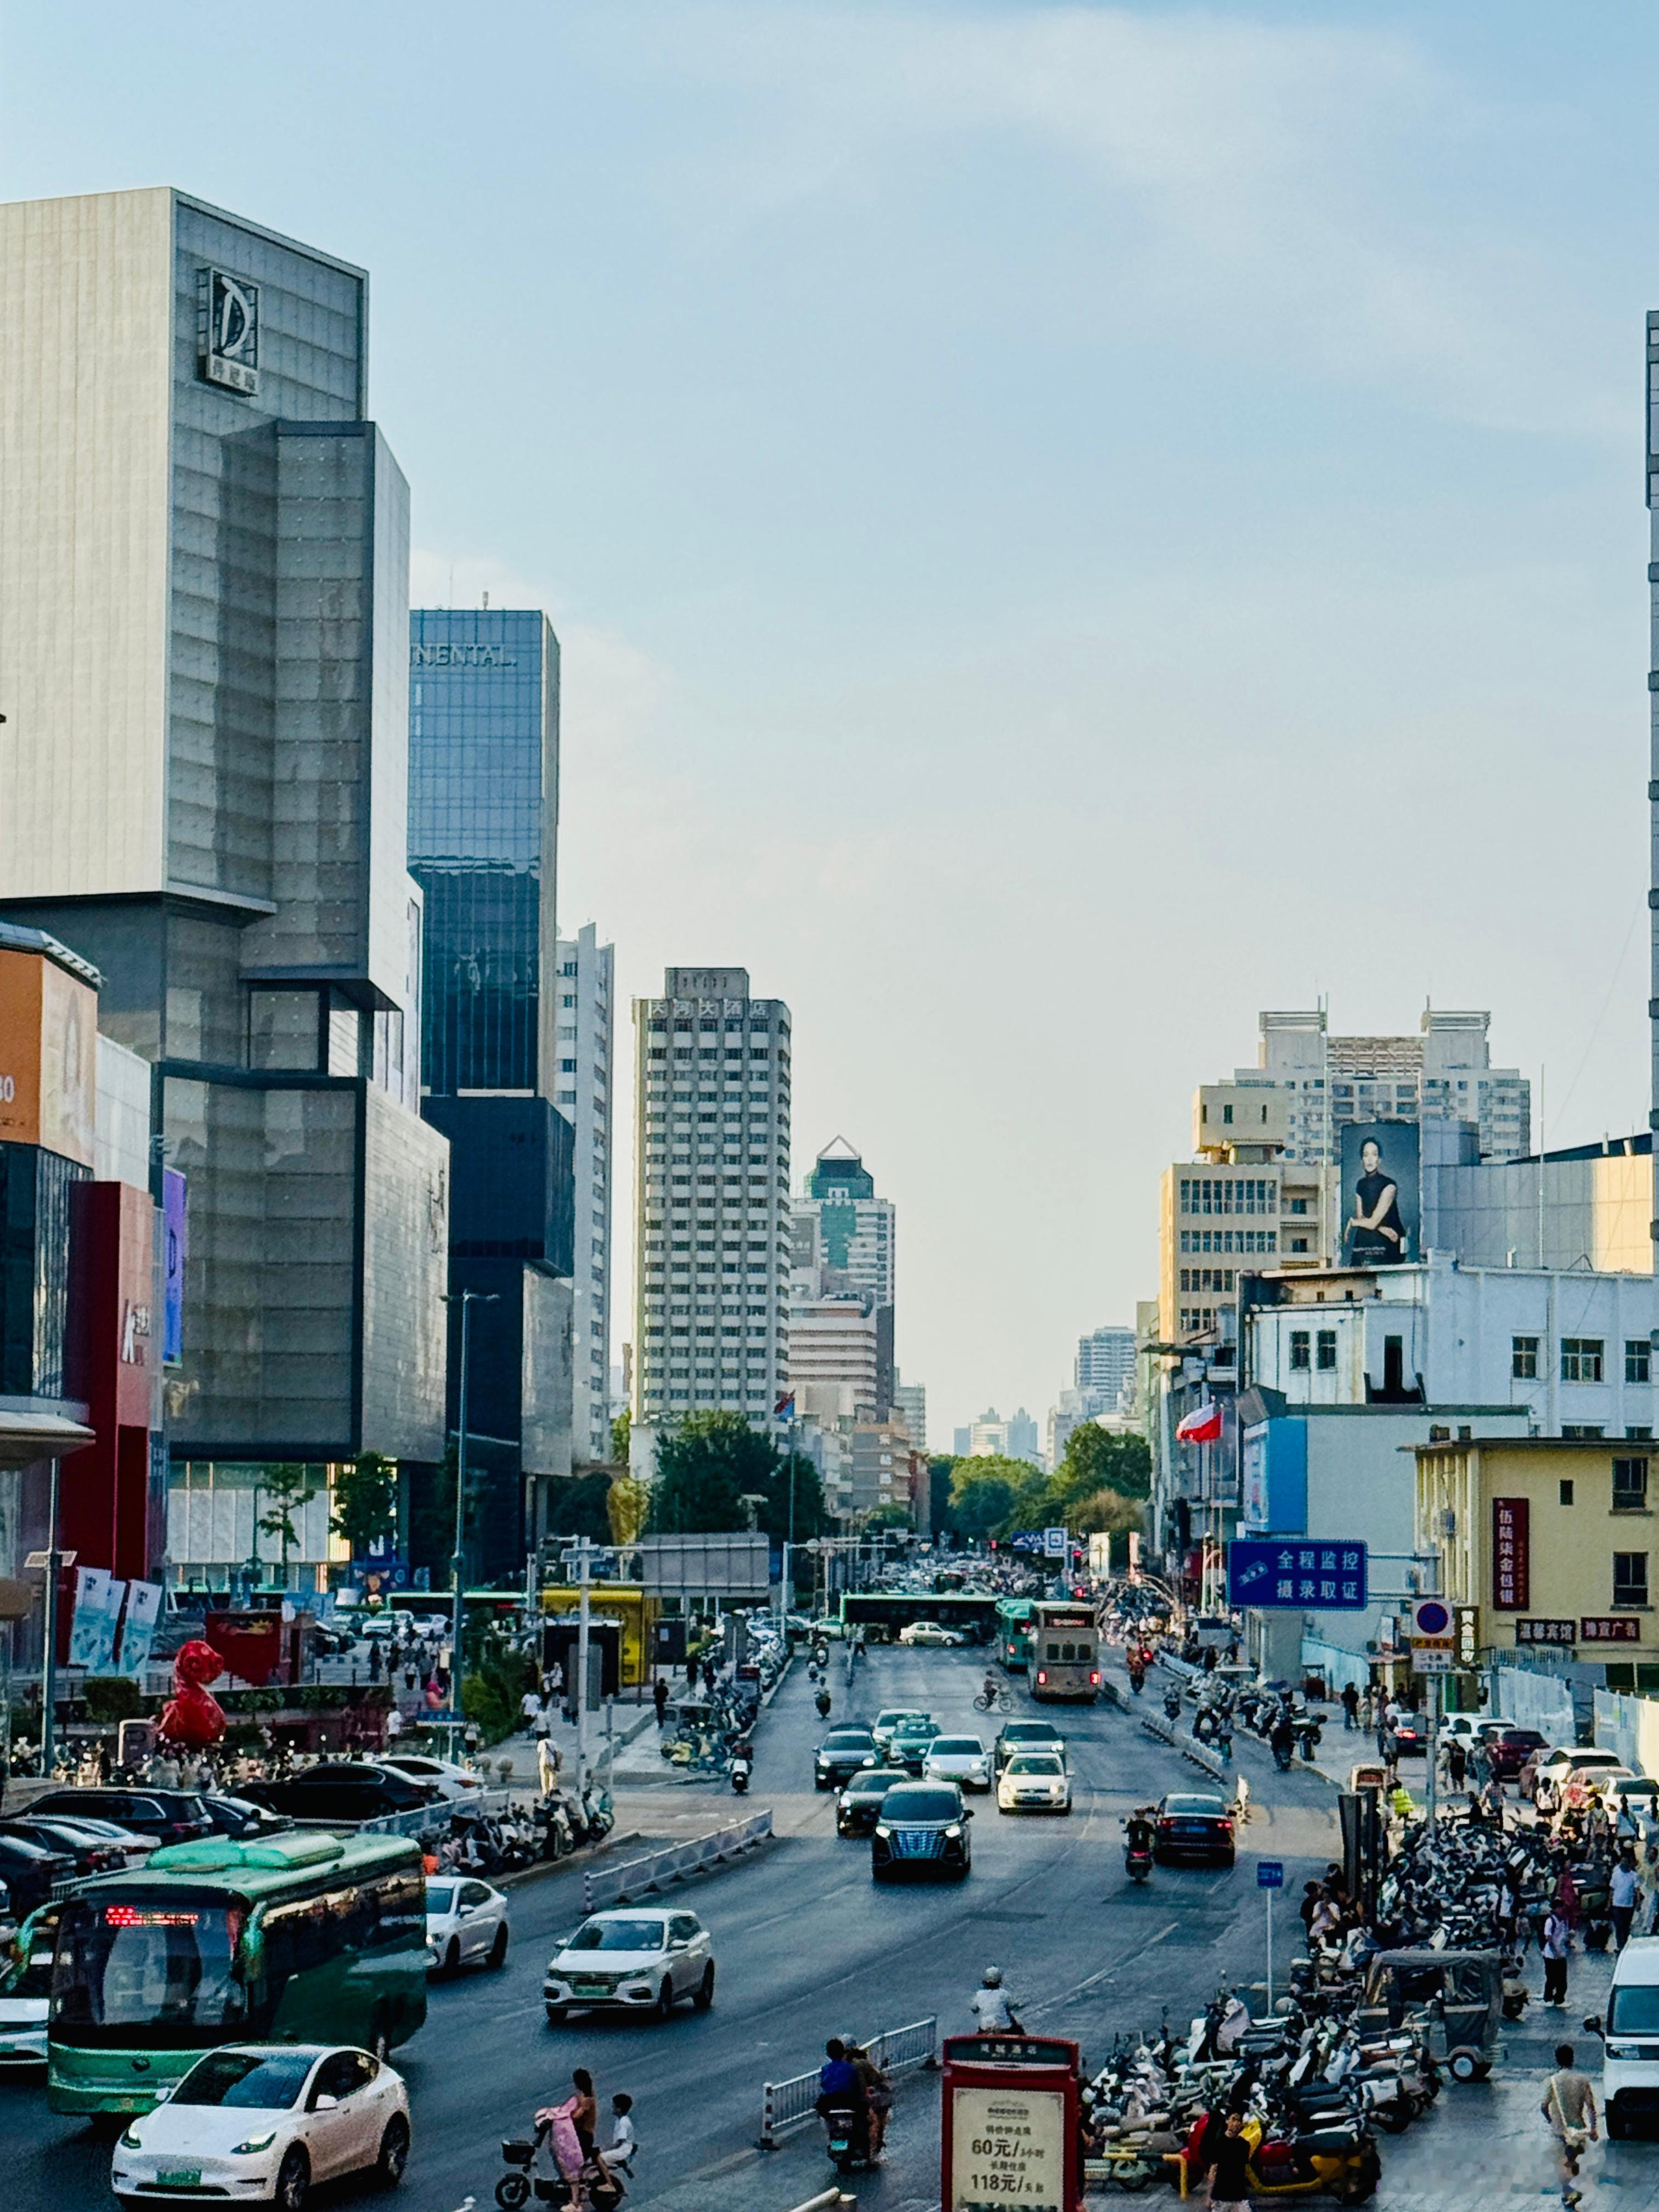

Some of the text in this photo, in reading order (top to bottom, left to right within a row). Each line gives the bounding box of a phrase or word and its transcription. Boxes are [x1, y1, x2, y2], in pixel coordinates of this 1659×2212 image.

[1278, 1549, 1359, 1570] 全程监控
[1499, 1510, 1514, 1603] 伍陆柒金包银
[1277, 1579, 1358, 1600] 摄录取证
[1520, 1622, 1573, 1640] 温馨宾馆
